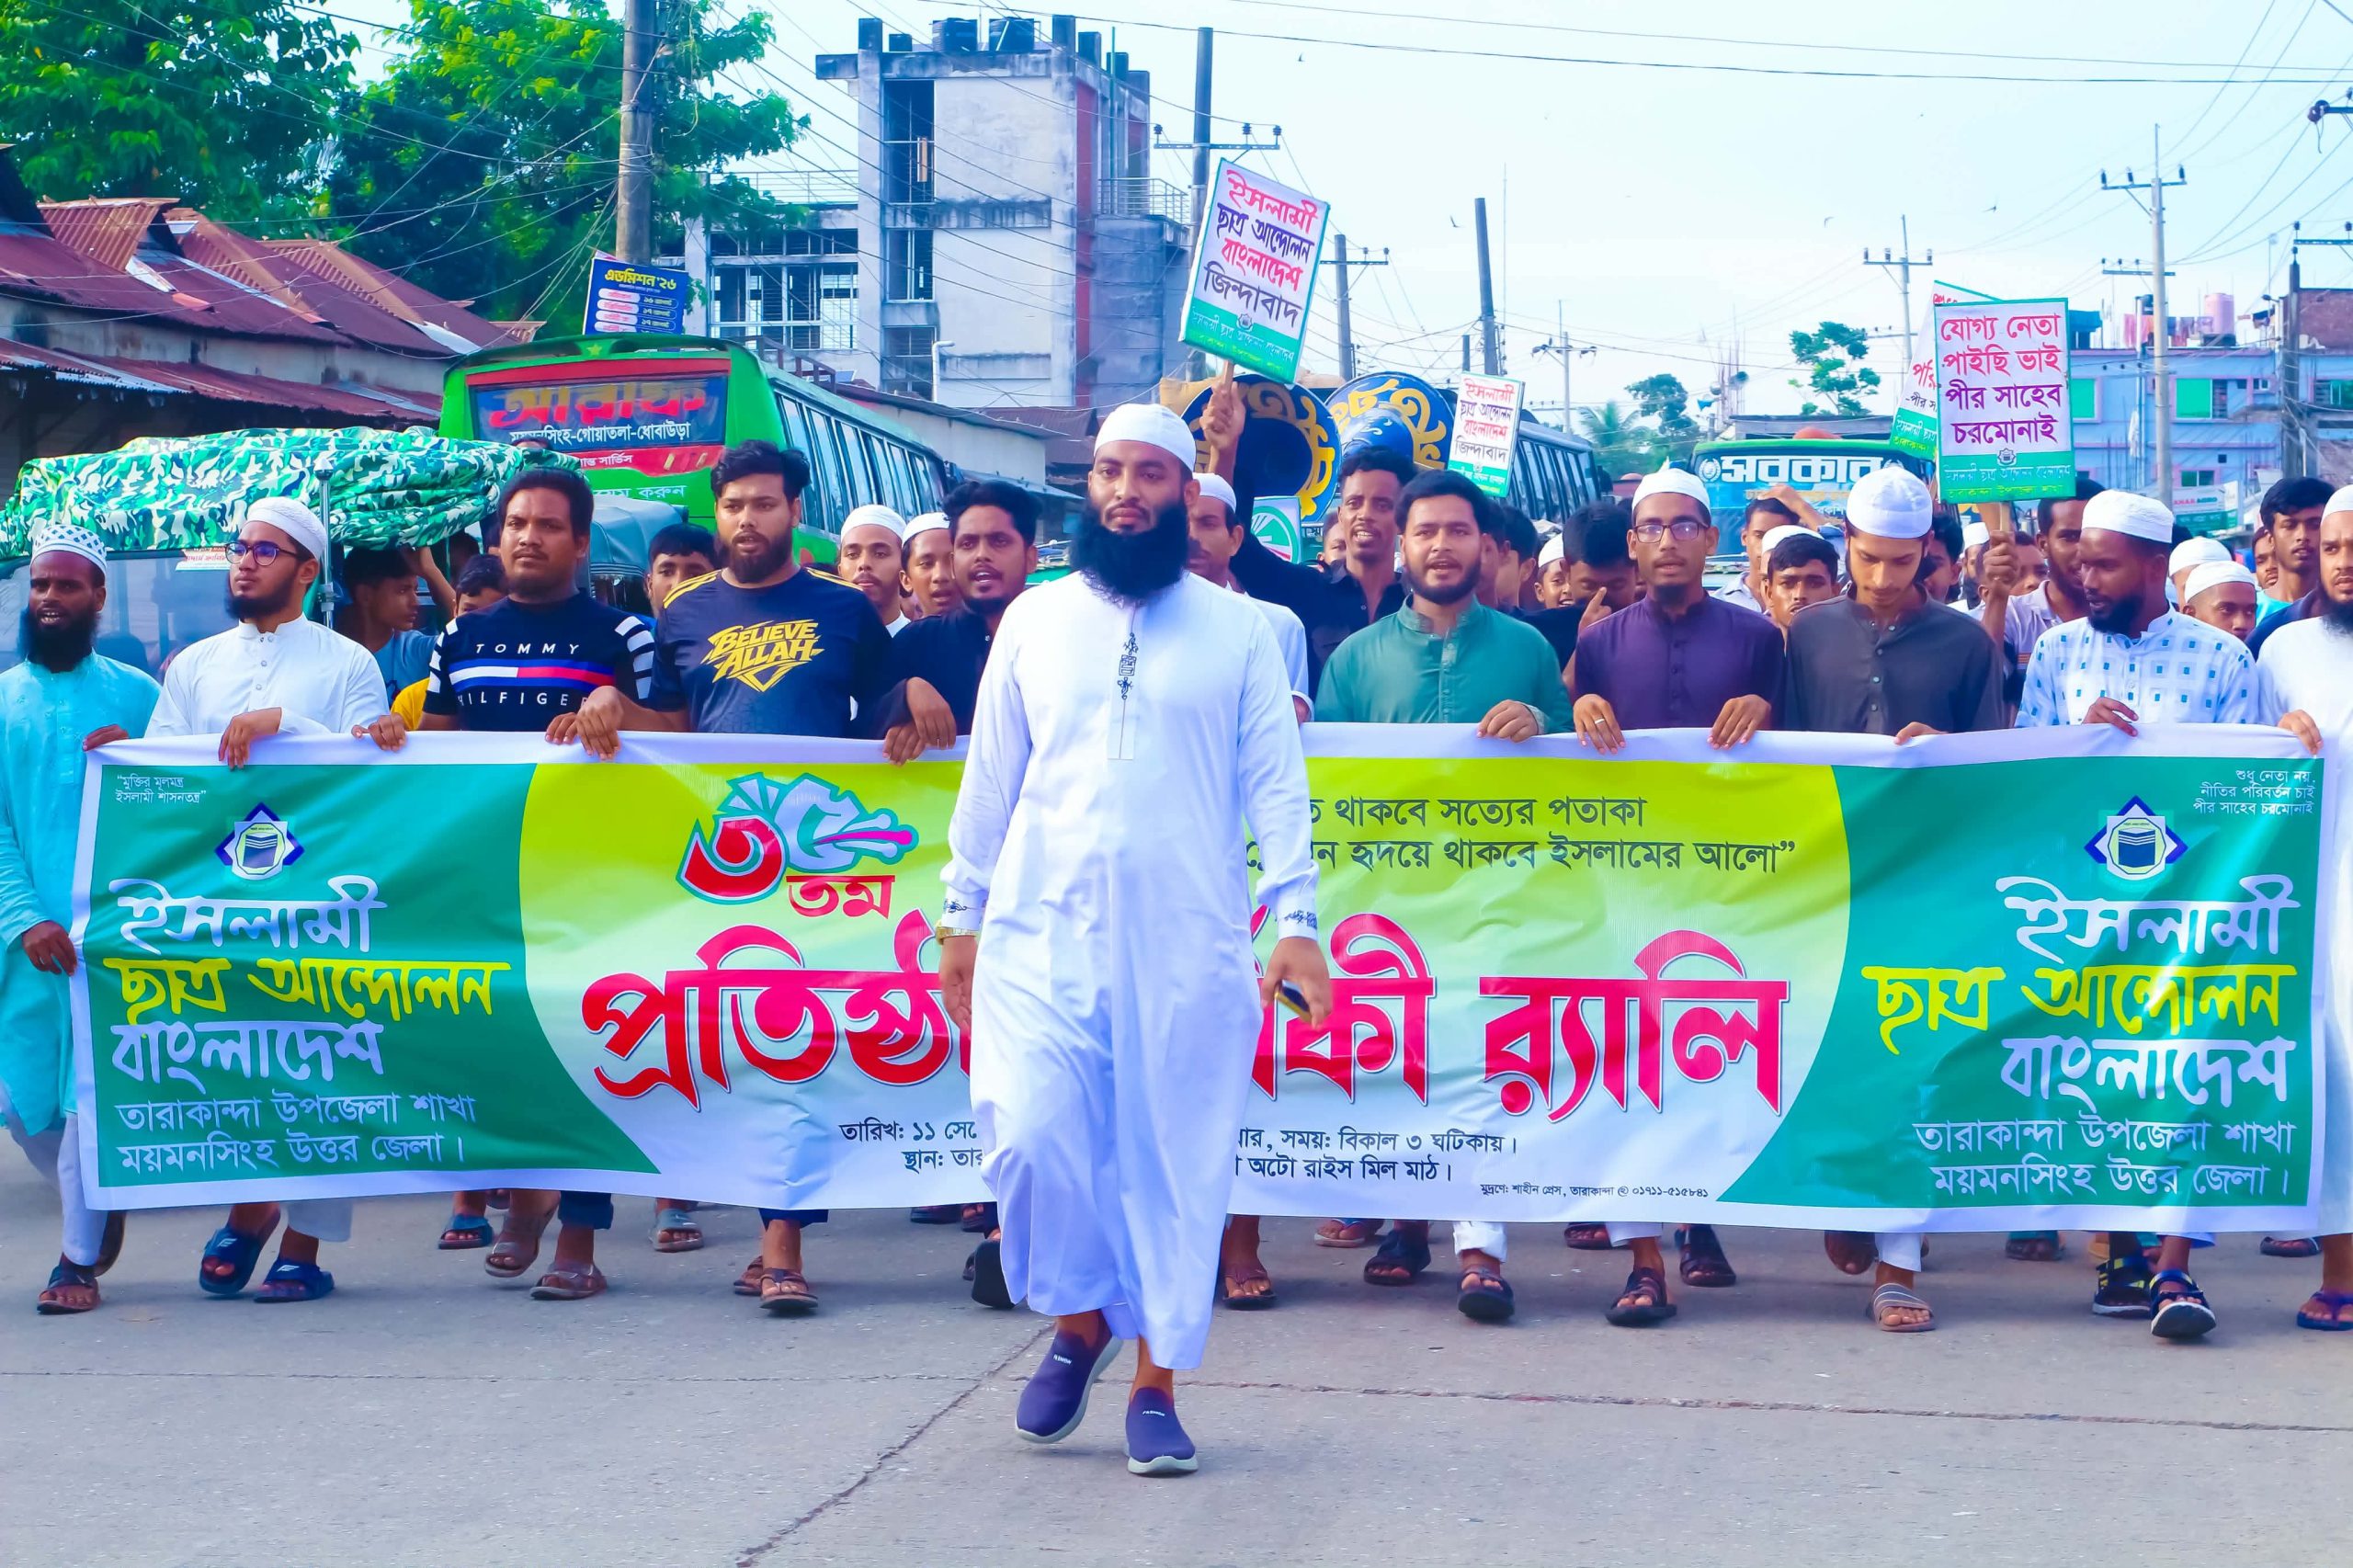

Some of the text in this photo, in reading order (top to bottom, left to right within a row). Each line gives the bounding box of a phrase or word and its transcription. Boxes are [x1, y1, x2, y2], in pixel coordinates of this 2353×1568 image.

[1226, 169, 1319, 233] ইসলামী
[1216, 202, 1314, 264] ছাত্র আন্দোলন
[605, 267, 656, 287] এডমিশন
[1221, 237, 1303, 291] বাংলাদেশ
[1203, 261, 1302, 327] জিন্দাবাদ
[1940, 312, 2061, 341] যোগ্য নেতা
[1943, 343, 2010, 377] পাইছি
[2015, 342, 2063, 374] ভাই
[1463, 378, 1515, 403] ইসলামী
[1945, 378, 1988, 410] পীর
[1992, 382, 2063, 409] সাহেব
[1463, 419, 1508, 439] বাংলাদেশ
[1950, 412, 2059, 444] চরমোনাই
[598, 451, 633, 466] সার্ভিস
[1454, 435, 1508, 462] জিন্দাবাদ
[638, 485, 688, 499] করুন
[475, 643, 580, 654] TOMMY
[704, 620, 819, 661] BELIEVE
[712, 638, 820, 683] ALLAH
[2200, 781, 2316, 799] নীতির পরিবর্তন চাই
[2235, 769, 2256, 785] শুধু
[2259, 770, 2289, 782] নেতা
[115, 789, 153, 803] ইসলামী
[1335, 795, 1430, 826] থাকবে
[1437, 798, 1538, 827] সত্যের
[1548, 795, 1648, 826] পতাকা
[2193, 798, 2315, 816] পীর সাহেব চরমোনাই
[1347, 840, 1435, 872] হৃদয়ে
[1443, 838, 1540, 869] থাকবে
[1546, 831, 1685, 870] ইসলামের
[1692, 840, 1795, 873] আলো”
[786, 874, 895, 919] তম
[108, 874, 388, 955] ইসলামী
[1995, 874, 2301, 964] ইসলামী
[103, 957, 511, 1025] ছাত্র আন্দোলন
[1860, 963, 2298, 1055] ছাত্র আন্দোলন
[111, 1020, 384, 1095] বাংলাদেশ
[2001, 1034, 2297, 1114] বাংলাদেশ
[114, 1088, 476, 1132] তারাকান্দা উপজেলা শাখা
[838, 1116, 904, 1142] তারিখ:
[913, 1121, 936, 1142] ১১
[1337, 1126, 1399, 1151] বিকাল
[1406, 1132, 1422, 1150] ৩
[1912, 1110, 2298, 1154] তারাকান্দা উপজেলা শাখা
[116, 1130, 280, 1174] ময়মনসিংহ
[285, 1131, 362, 1164] উত্তর
[901, 1149, 943, 1175] স্থান:
[1246, 1153, 1298, 1178] অটো
[1302, 1153, 1356, 1179] রাইস
[1359, 1153, 1399, 1182] মিল
[1511, 1182, 1540, 1196] শাহীন
[1569, 1186, 1614, 1198] তারাকান্দা
[1929, 1152, 2097, 1196] ময়মনসিংহ
[2105, 1153, 2182, 1194] উত্তর
